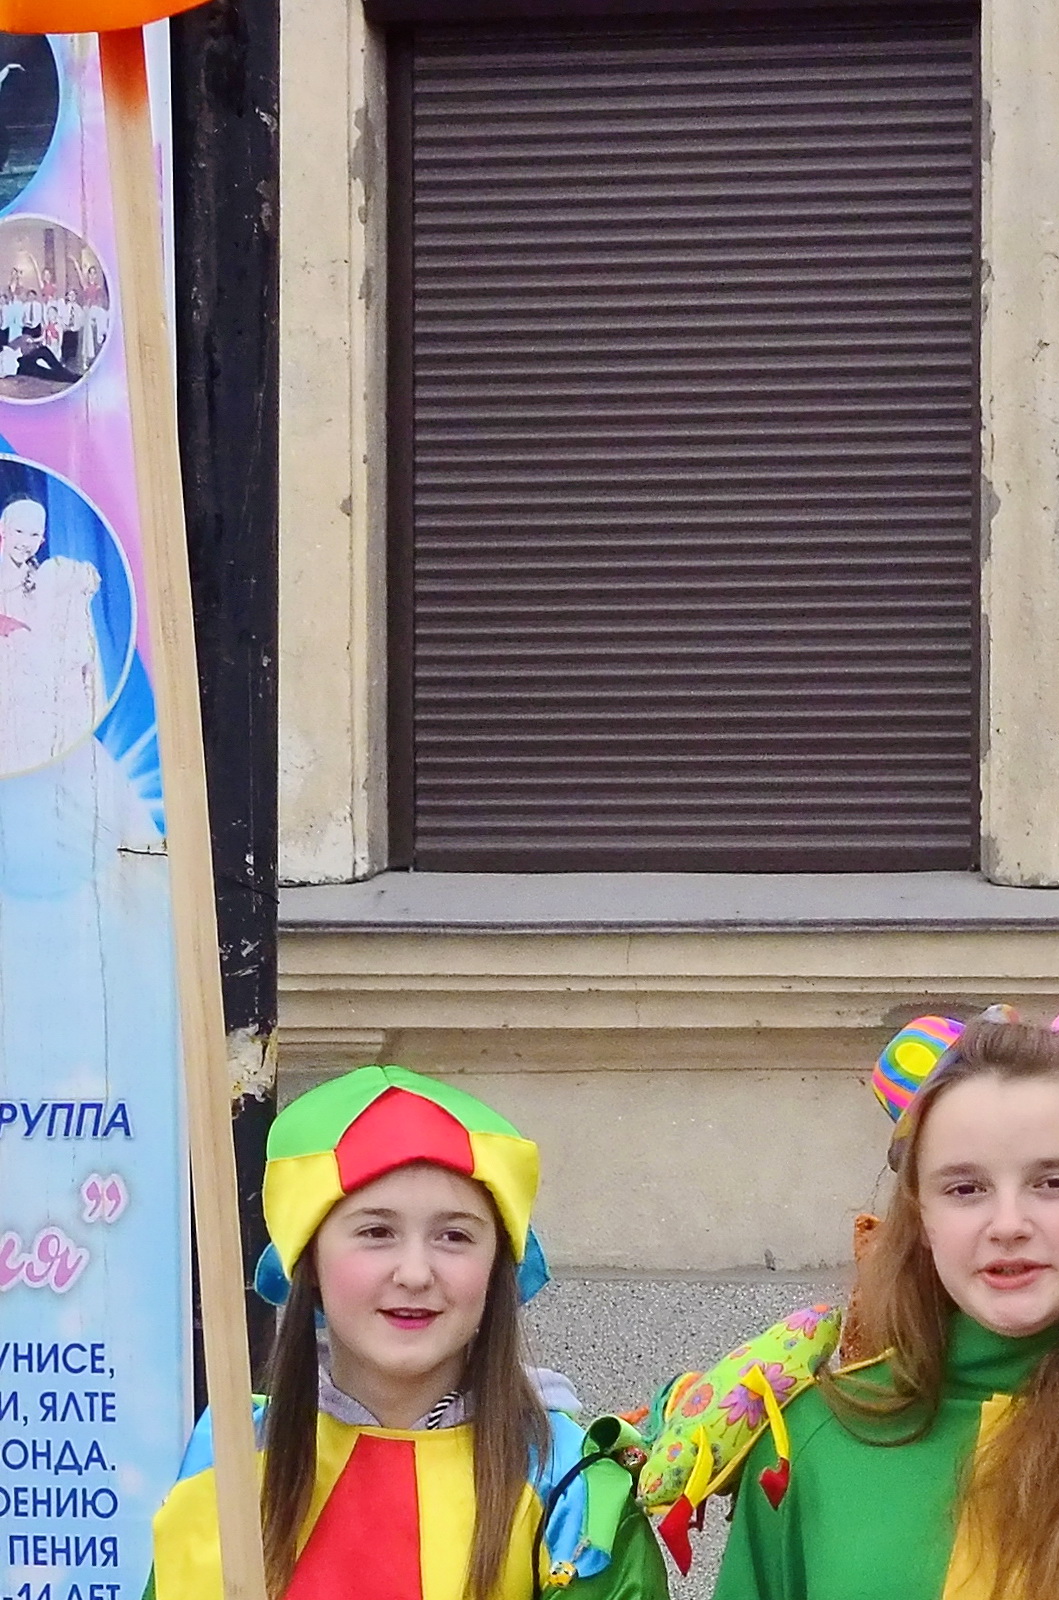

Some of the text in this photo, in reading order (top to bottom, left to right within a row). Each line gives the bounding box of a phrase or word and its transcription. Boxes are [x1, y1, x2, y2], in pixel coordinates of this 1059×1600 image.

[0, 1102, 131, 1138] РУППА
[39, 1391, 117, 1423] ЯЛТЕ
[1, 1438, 116, 1476] ОНДА.
[9, 1535, 118, 1567] ПЕНИЯ
